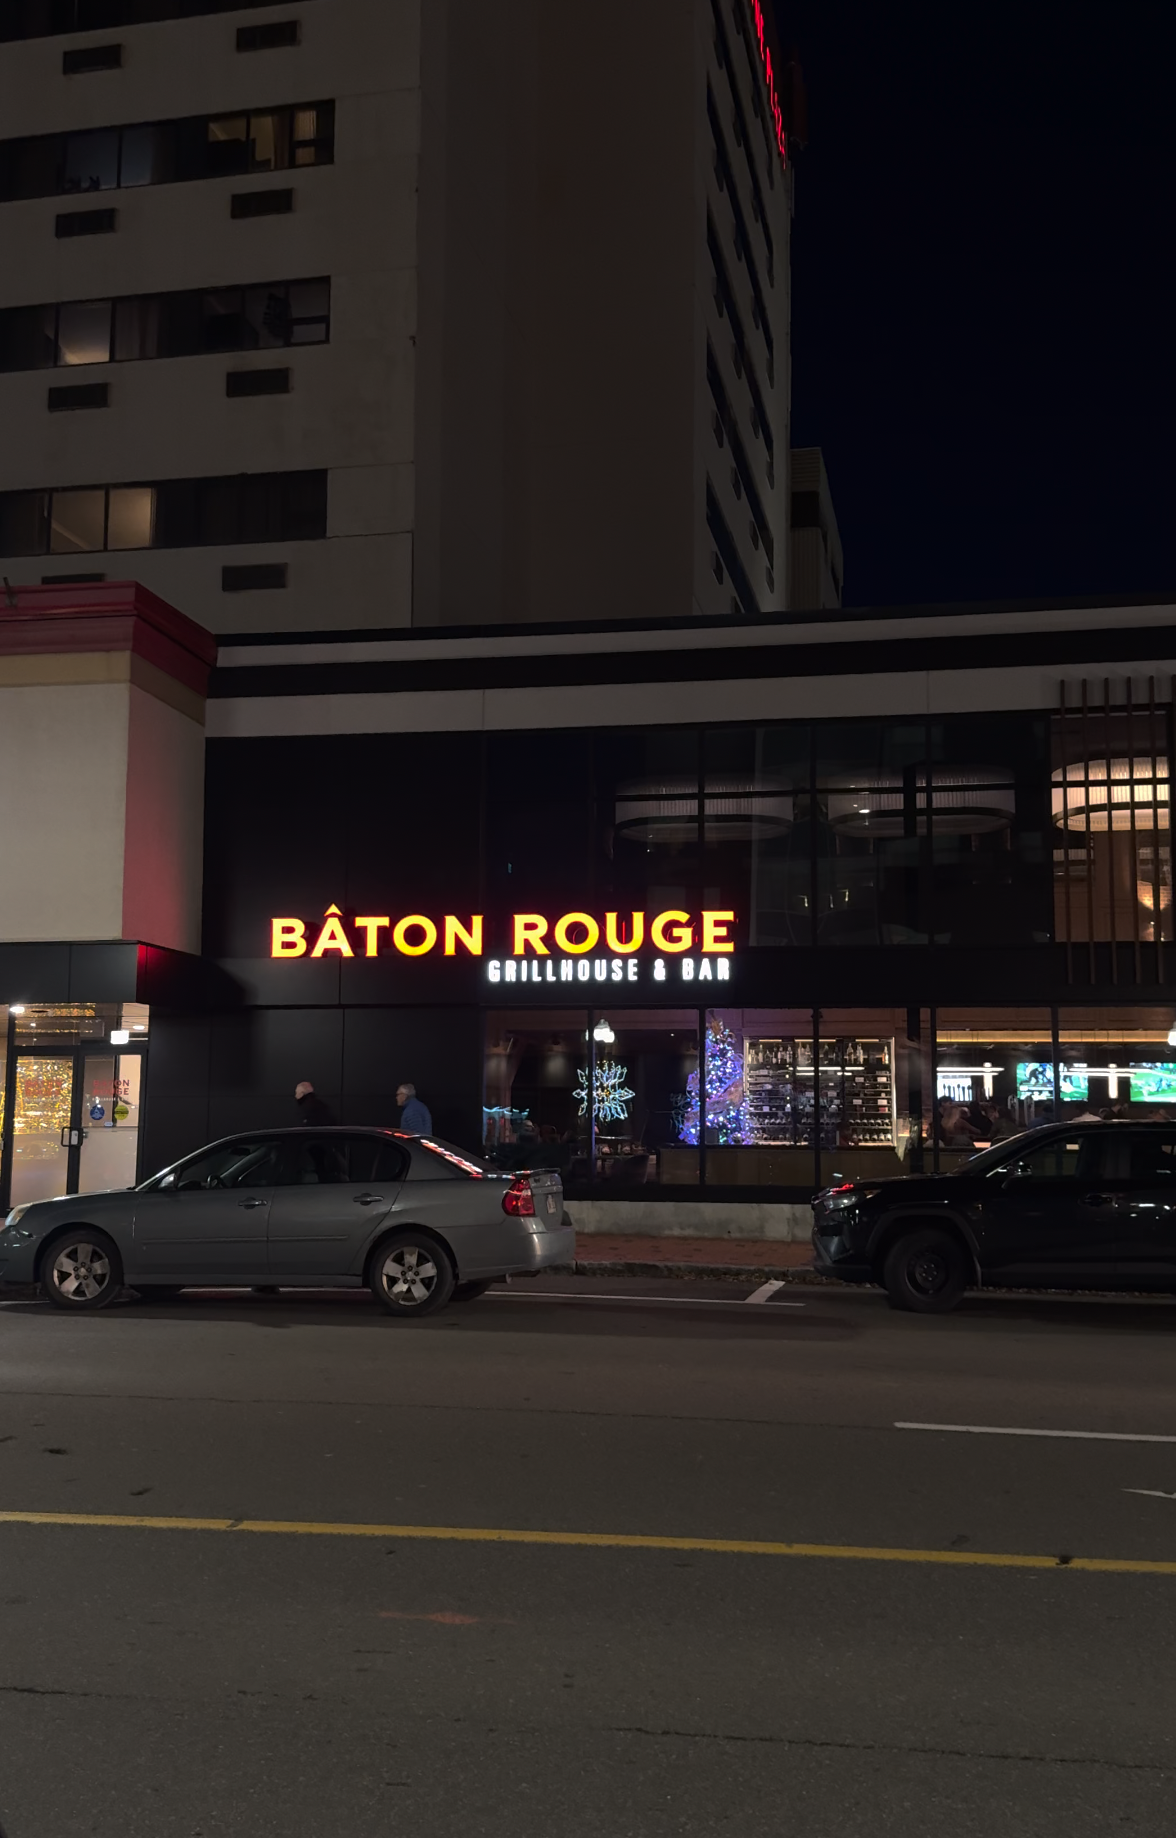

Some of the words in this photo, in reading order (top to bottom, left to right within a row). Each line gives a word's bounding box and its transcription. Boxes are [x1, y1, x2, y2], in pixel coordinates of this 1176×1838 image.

[271, 904, 484, 957] BÂTON
[513, 910, 735, 956] ROUGE
[486, 959, 639, 982] GRILLHOUSE
[653, 958, 666, 980] &
[682, 957, 730, 980] BAR
